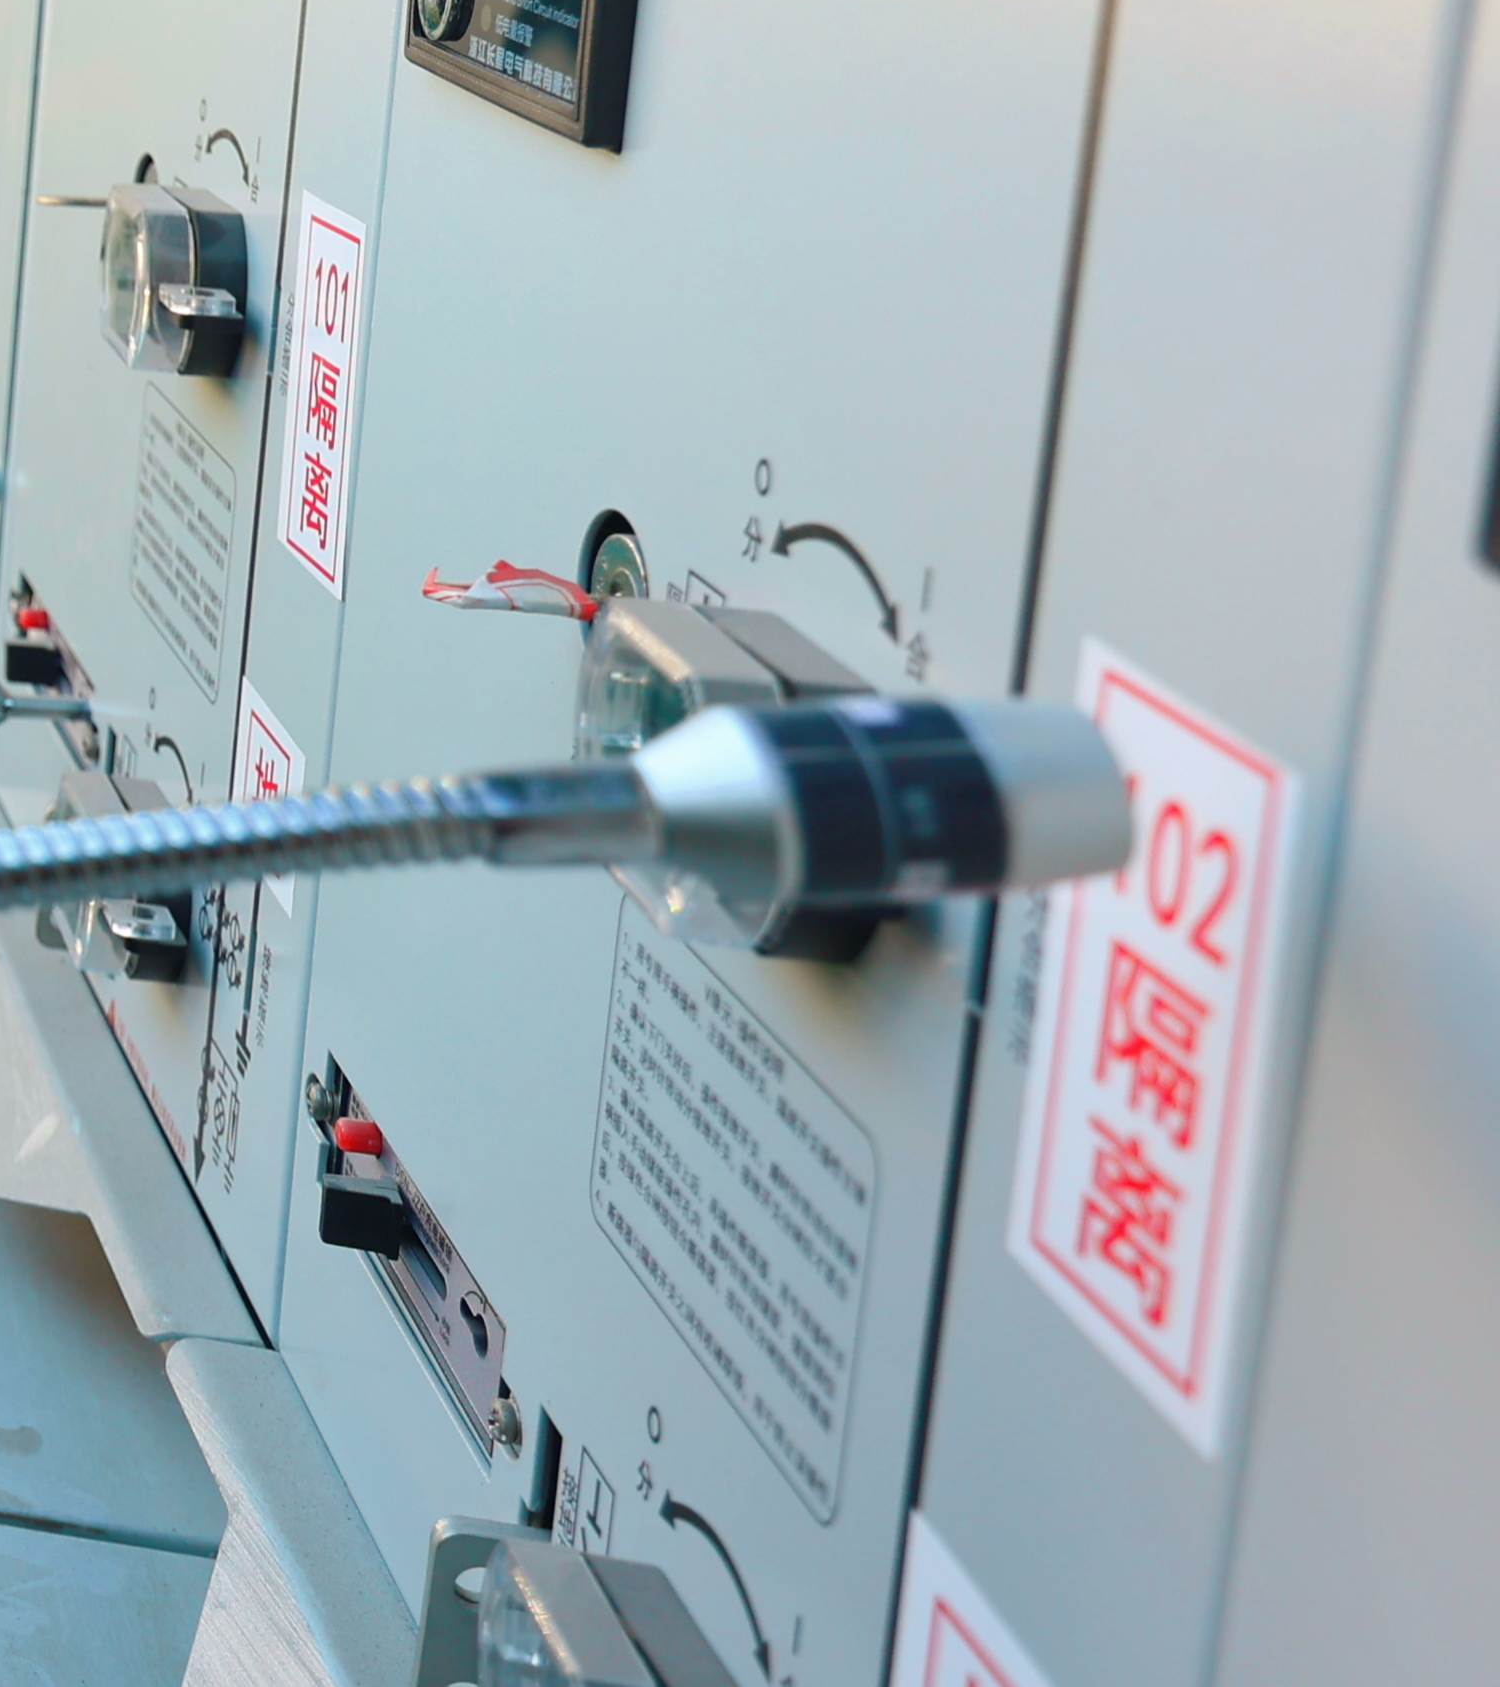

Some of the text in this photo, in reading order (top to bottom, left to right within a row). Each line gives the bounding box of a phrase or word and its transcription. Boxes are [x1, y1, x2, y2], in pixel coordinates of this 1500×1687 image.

[468, 34, 578, 102] 浙江长星电气科技有限公
[314, 256, 350, 344] 101
[300, 350, 341, 552] 隔离
[741, 514, 763, 563] 分
[905, 630, 930, 683] 合
[1076, 939, 1213, 1326] 隔离
[636, 1458, 653, 1501] 分
